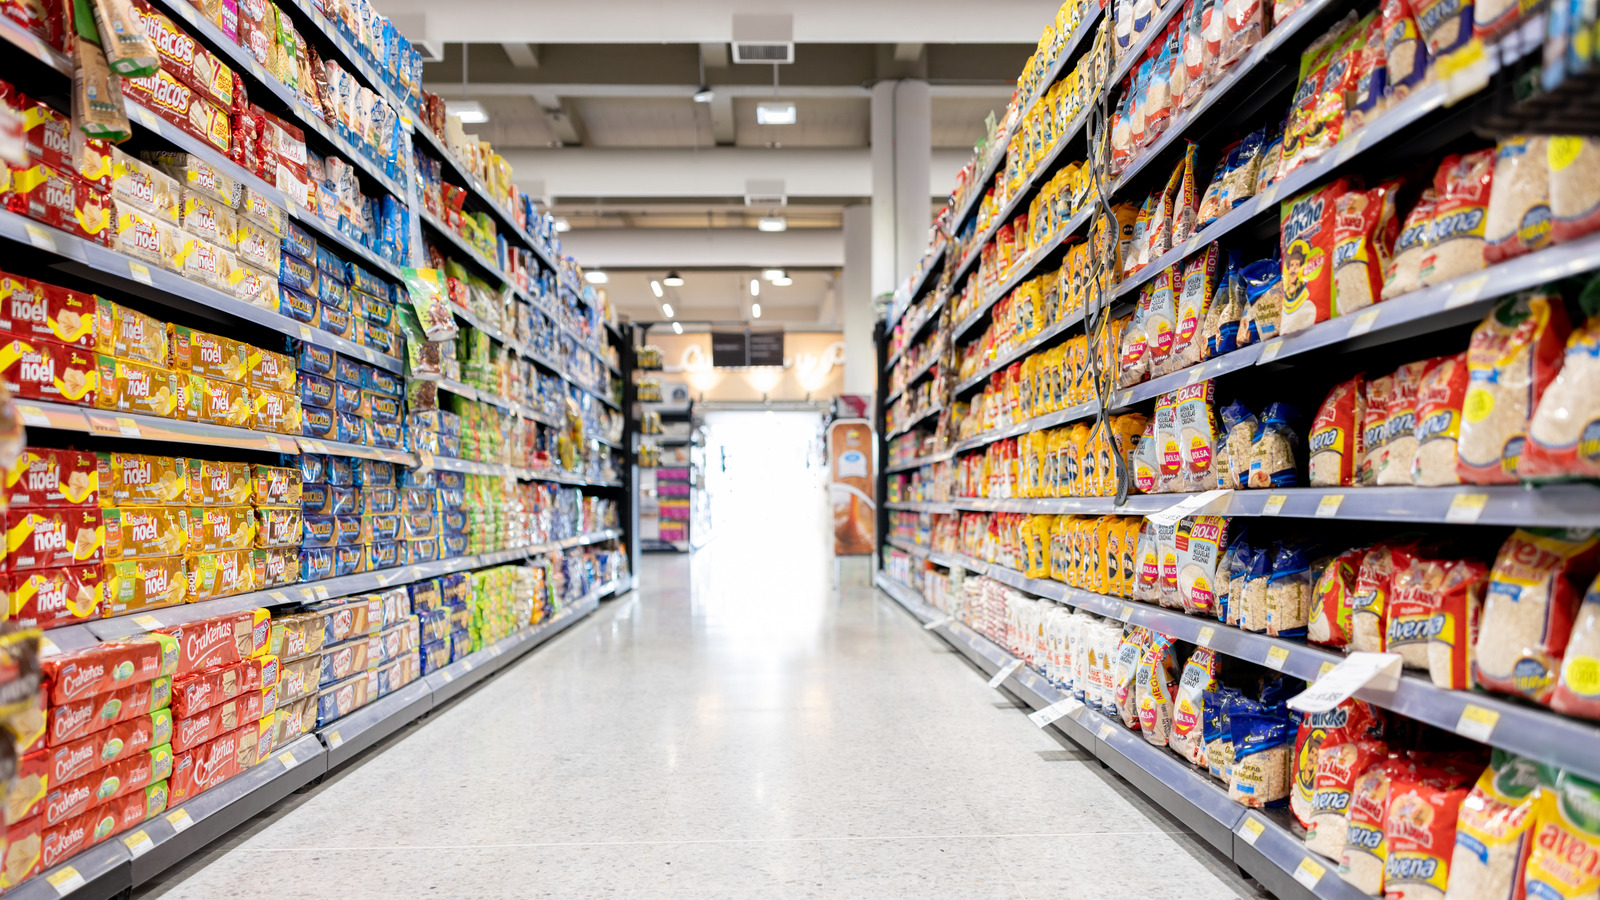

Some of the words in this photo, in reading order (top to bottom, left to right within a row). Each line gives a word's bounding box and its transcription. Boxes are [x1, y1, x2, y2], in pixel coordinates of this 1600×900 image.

[132, 9, 194, 64] altitacos
[130, 178, 154, 204] noel
[198, 174, 215, 190] noel
[1184, 172, 1194, 206] GRATIS
[46, 186, 76, 216] noel
[198, 213, 217, 231] noel
[135, 229, 160, 252] noel
[198, 253, 217, 272] noel
[245, 280, 262, 296] noel
[1203, 280, 1214, 311] MEGA
[12, 299, 48, 323] noel
[123, 320, 144, 342] noel
[201, 345, 222, 365] noel
[262, 356, 278, 375] noel
[20, 358, 55, 383] noel
[127, 376, 150, 397] noel
[212, 391, 229, 411] noel
[267, 397, 283, 418] noel
[1208, 407, 1219, 438] MEGA
[1191, 450, 1209, 460] BOLSA
[28, 464, 61, 490] noel
[124, 462, 152, 486] noel
[211, 469, 230, 492] noel
[34, 522, 67, 553] noel
[133, 517, 158, 542] noel
[214, 516, 232, 538] noel
[145, 569, 169, 596] noel
[1164, 567, 1177, 575] BOLS
[187, 571, 197, 596] noel
[37, 583, 68, 614] noel
[1191, 590, 1210, 601] BOLSA
[1388, 613, 1446, 641] Avena
[1313, 791, 1351, 810] vena
[1538, 823, 1600, 879] aven
